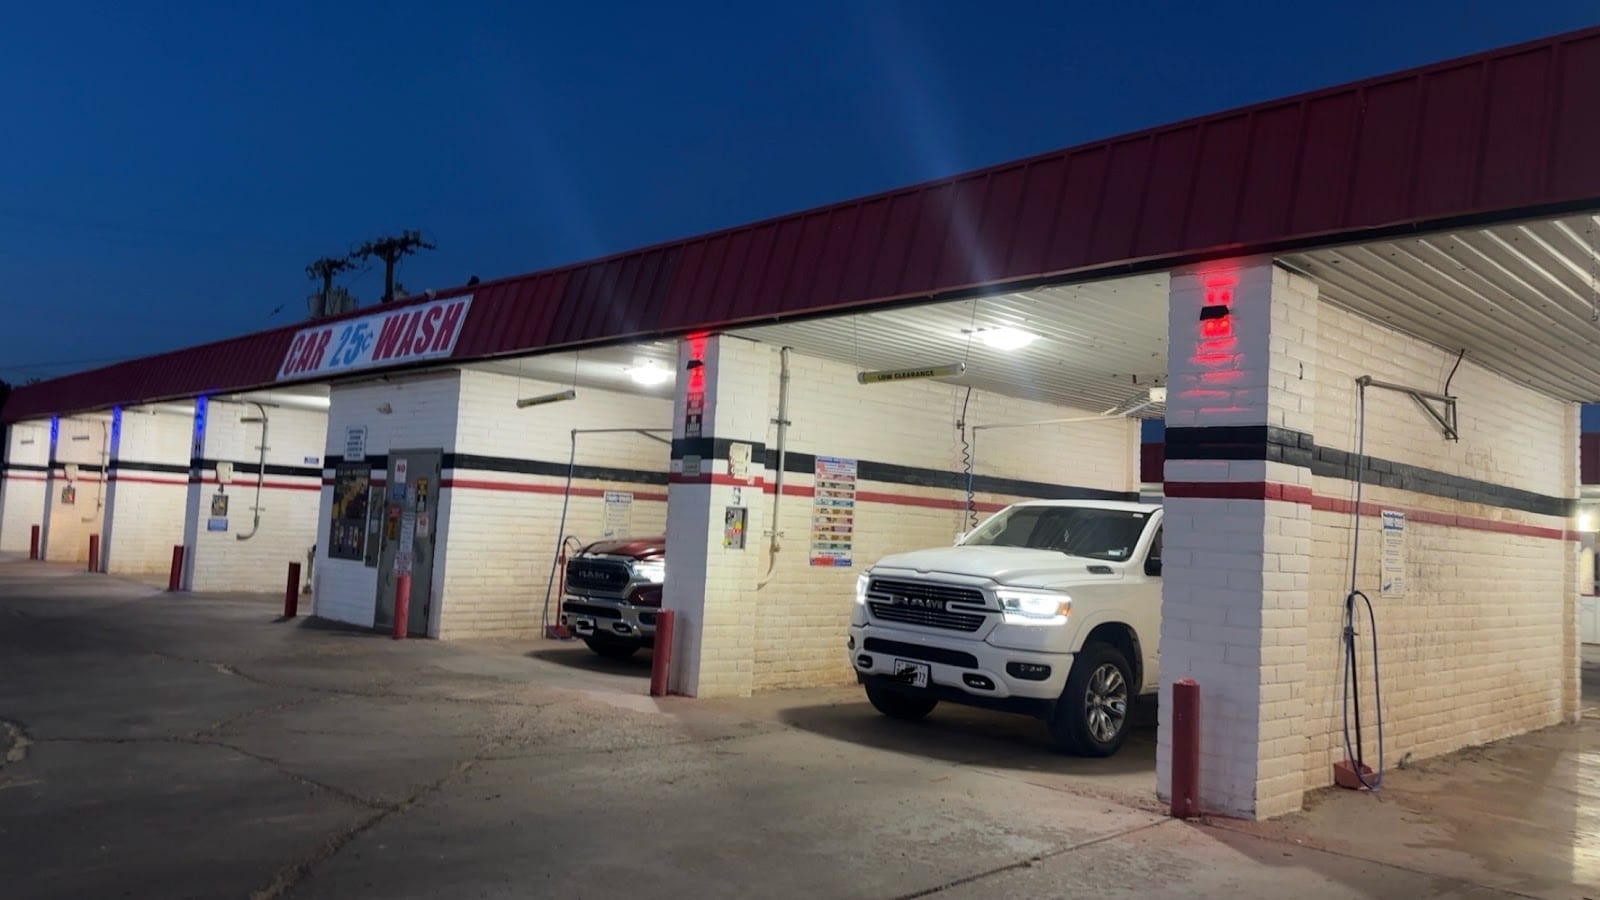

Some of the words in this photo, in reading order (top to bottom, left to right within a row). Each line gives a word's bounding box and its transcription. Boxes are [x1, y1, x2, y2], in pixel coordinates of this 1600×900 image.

[284, 329, 332, 376] CAR
[371, 301, 465, 361] WASH
[894, 370, 934, 379] CLEARANCE
[896, 597, 943, 609] RAM
